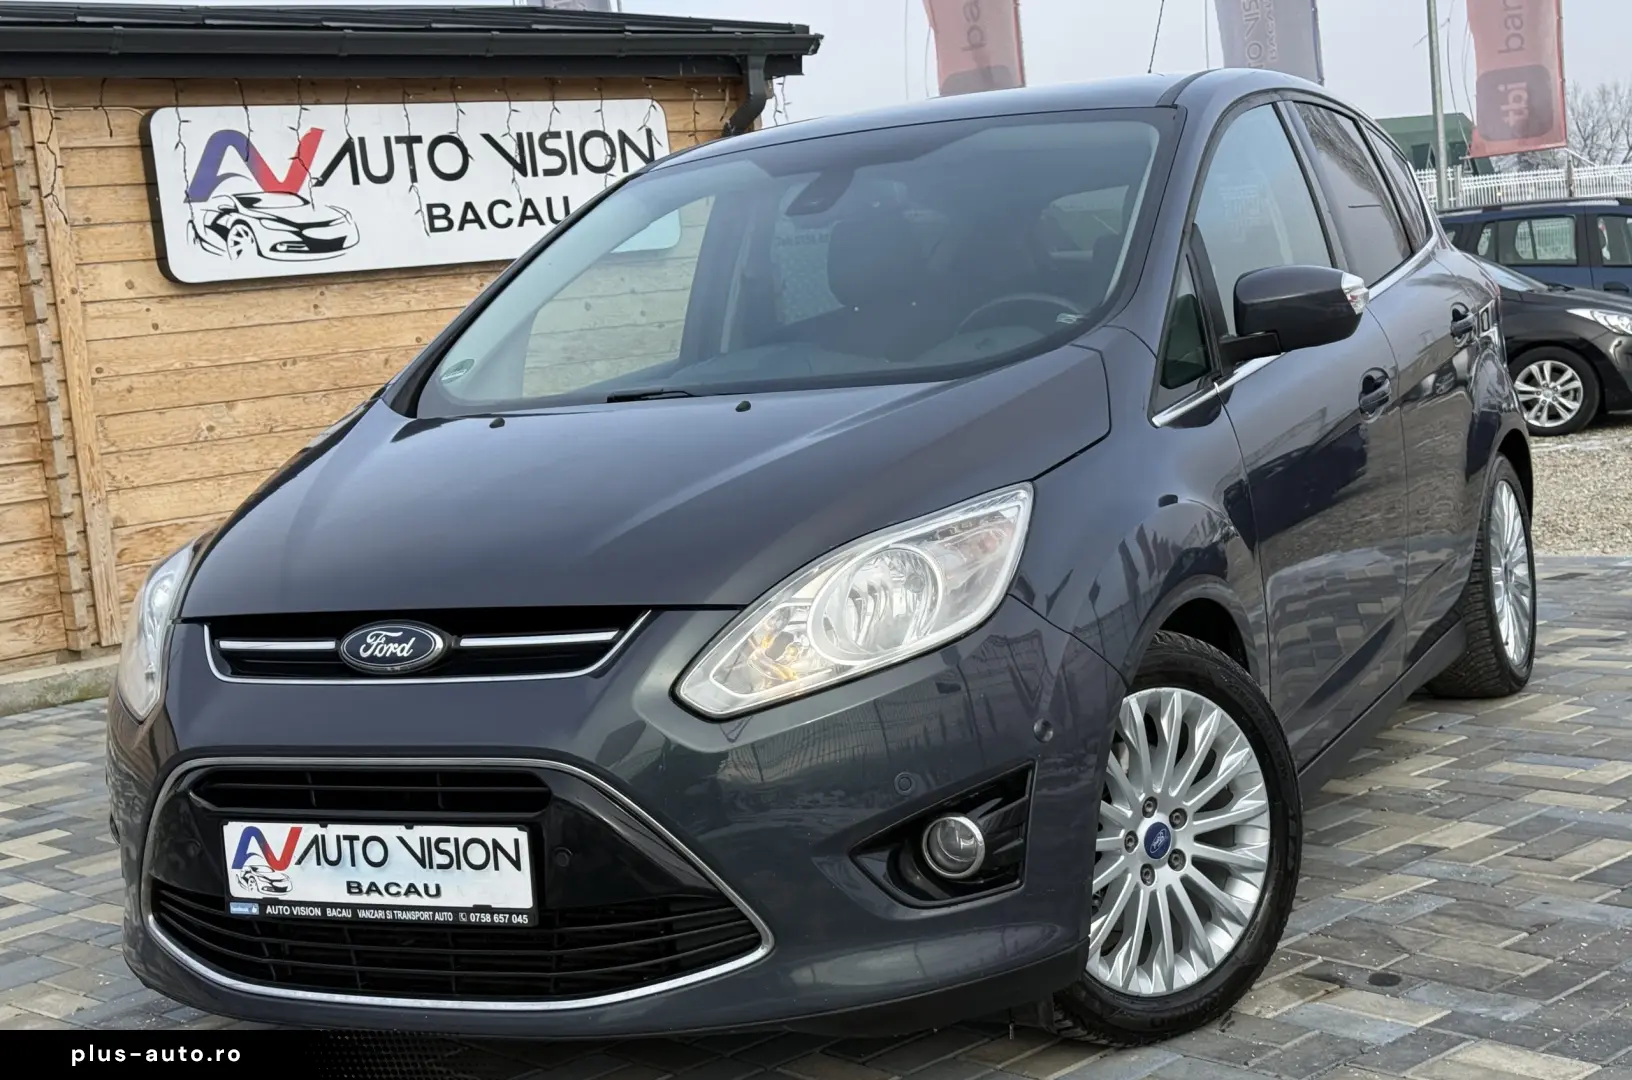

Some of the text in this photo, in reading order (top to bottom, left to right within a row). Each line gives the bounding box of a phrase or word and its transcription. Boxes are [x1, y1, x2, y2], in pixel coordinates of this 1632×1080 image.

[962, 0, 988, 51] ba
[1244, 0, 1260, 38] VIS
[1498, 0, 1529, 126] tbi ban
[313, 127, 656, 187] AUTO VISION
[428, 197, 571, 233] BACAU
[360, 631, 416, 658] Ford
[295, 834, 522, 871] AUTO VISION
[346, 880, 441, 898] BACAU
[266, 905, 528, 924] AUTO VISION BACAU VANZARI SI TRANSPORT AUTO 0758 657 045
